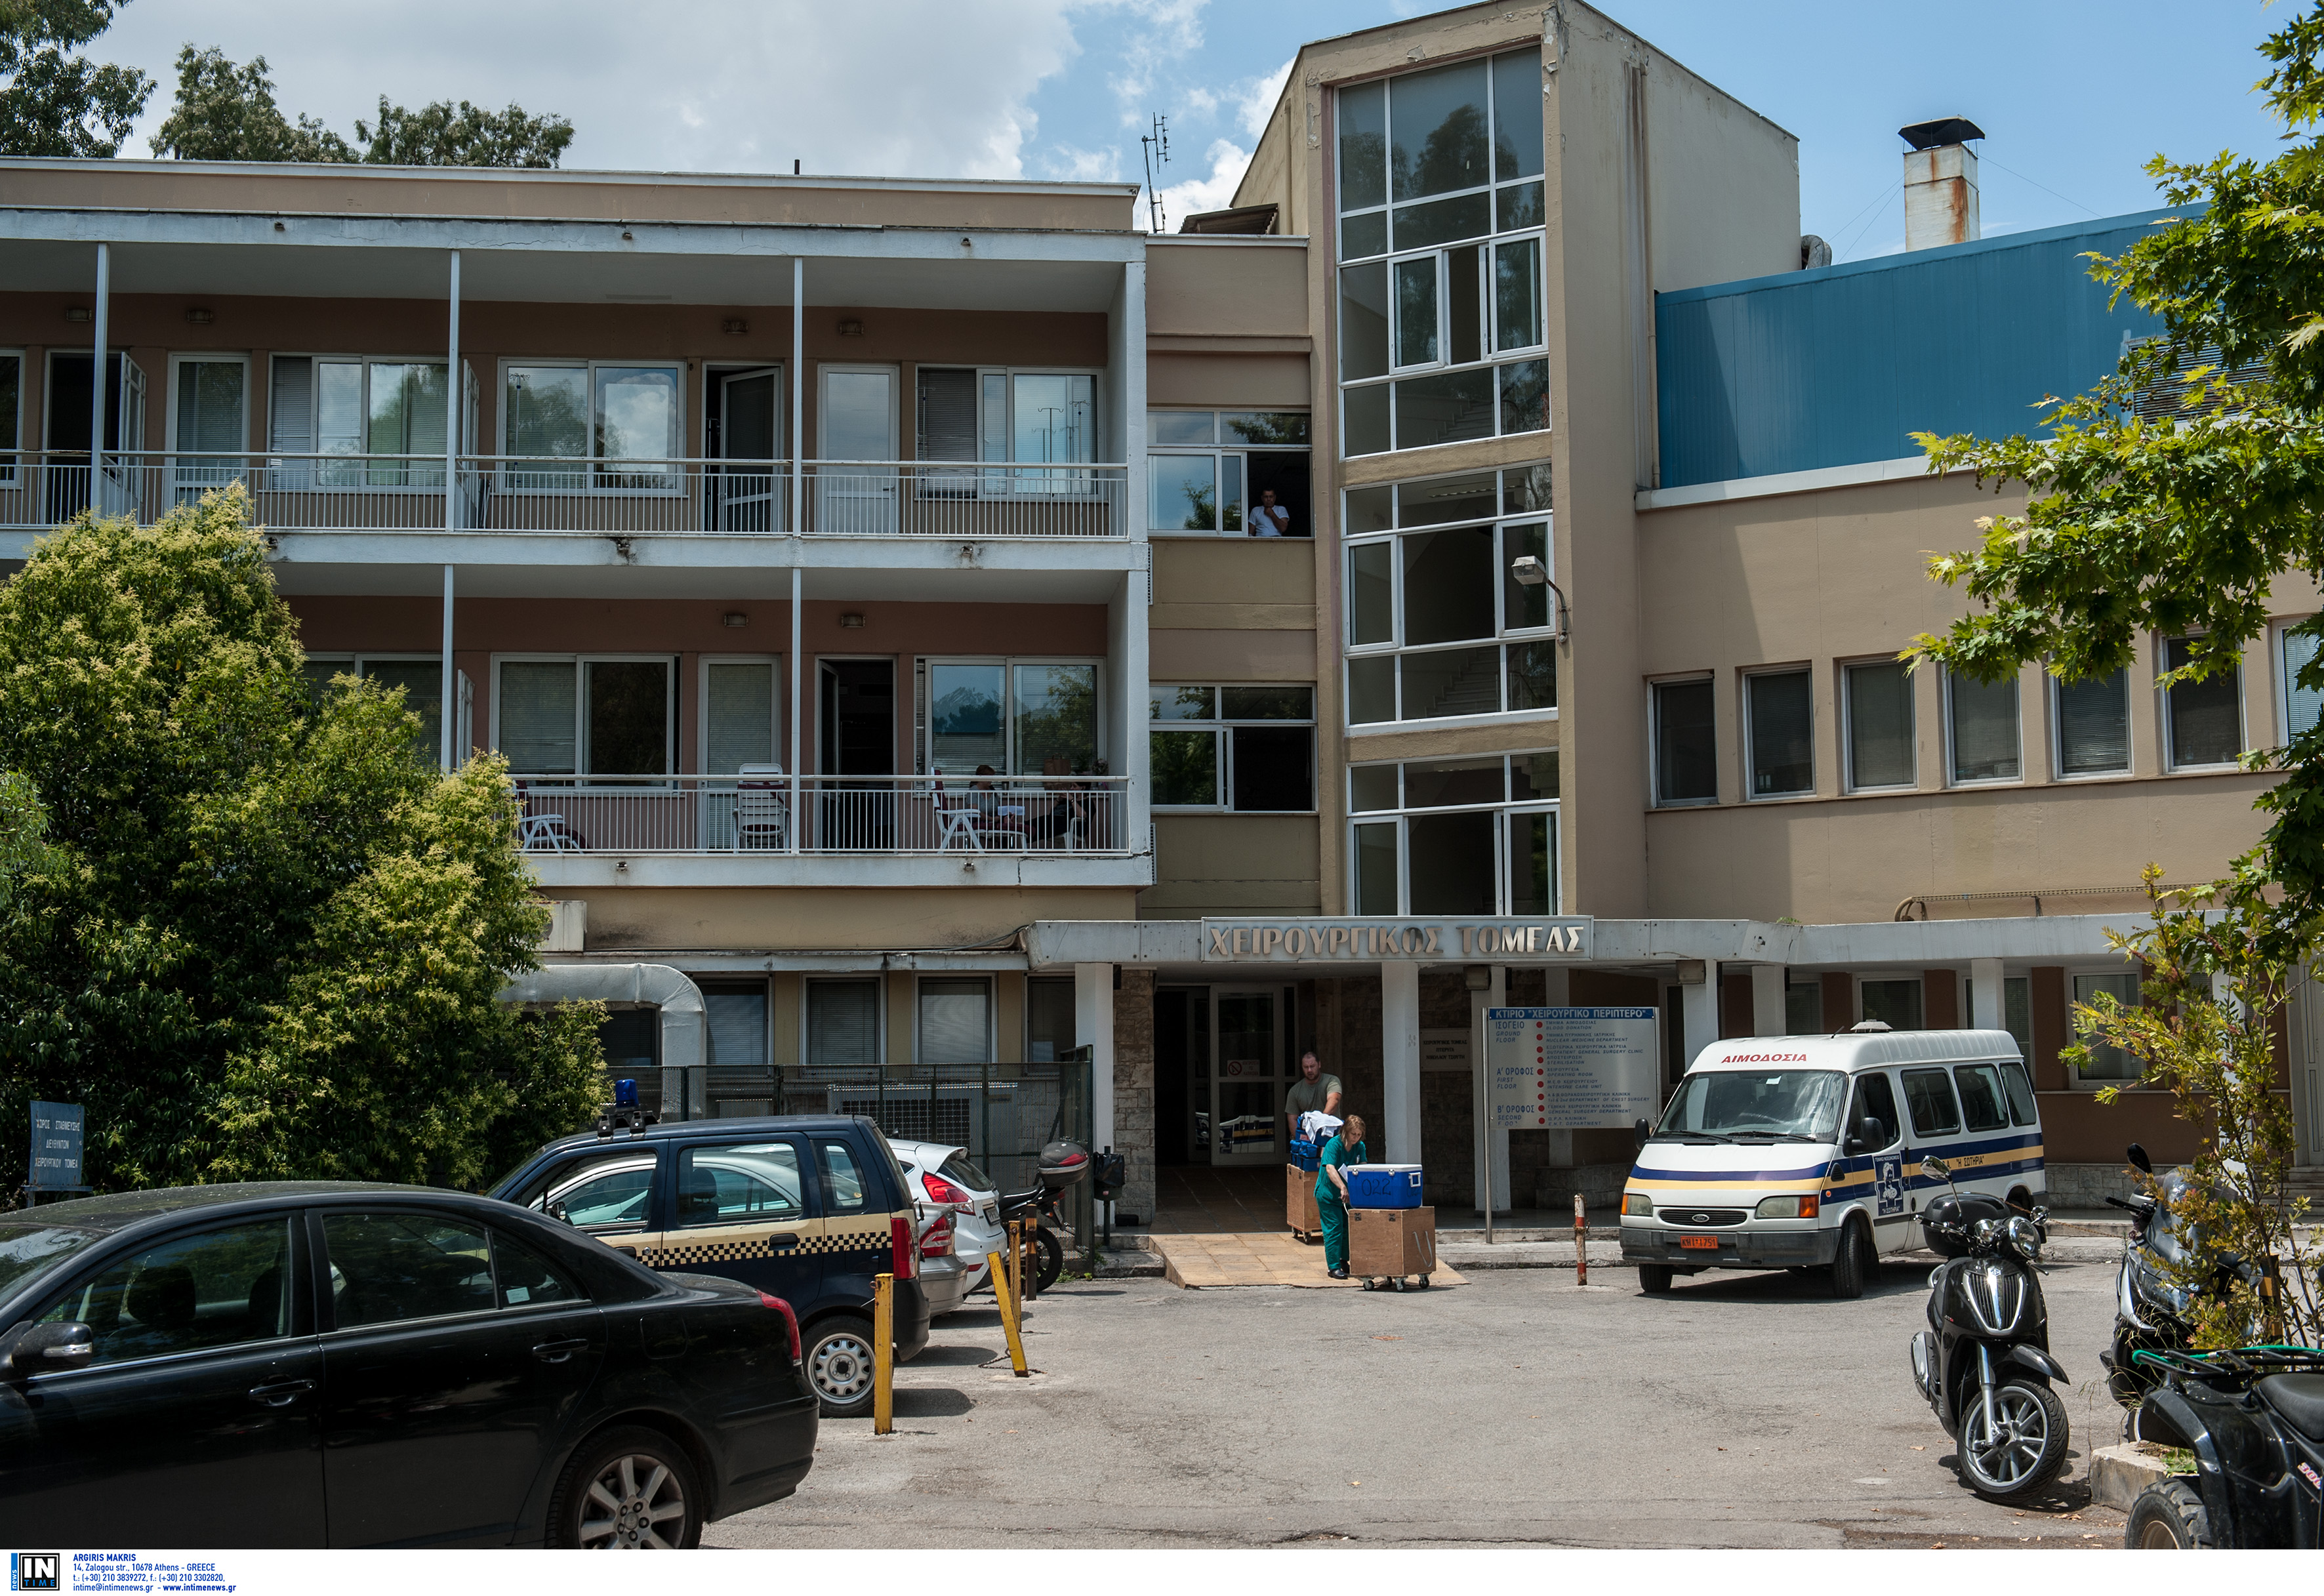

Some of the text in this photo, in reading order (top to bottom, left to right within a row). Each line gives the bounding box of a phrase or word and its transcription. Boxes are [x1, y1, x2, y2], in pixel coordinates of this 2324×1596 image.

[1209, 926, 1584, 956] ΧΕΙΡΟΥΡΓΙΚΟΣ ΤΟΜΕΑΣ
[1496, 1009, 1646, 1019] ΚΤΙΡΙΟ "ΧΕΙΡΟΥΡΓΙΚΟ ΠΕΡΙΠΤΕΡΟ"
[1496, 1021, 1524, 1029] ΙΣΟΓΕΙΟ
[1721, 1054, 1807, 1064] ΑΙΜΟΔΟΣΙΑ
[1505, 1067, 1534, 1075] ΟΡΟΦΟΣ
[1506, 1105, 1534, 1113] ΟΡΟΦΟΣ
[36, 1119, 51, 1129] ΧΩΡΟΣ
[64, 1158, 78, 1168] ΤΟΜΕΑ
[1362, 1178, 1391, 1196] 022
